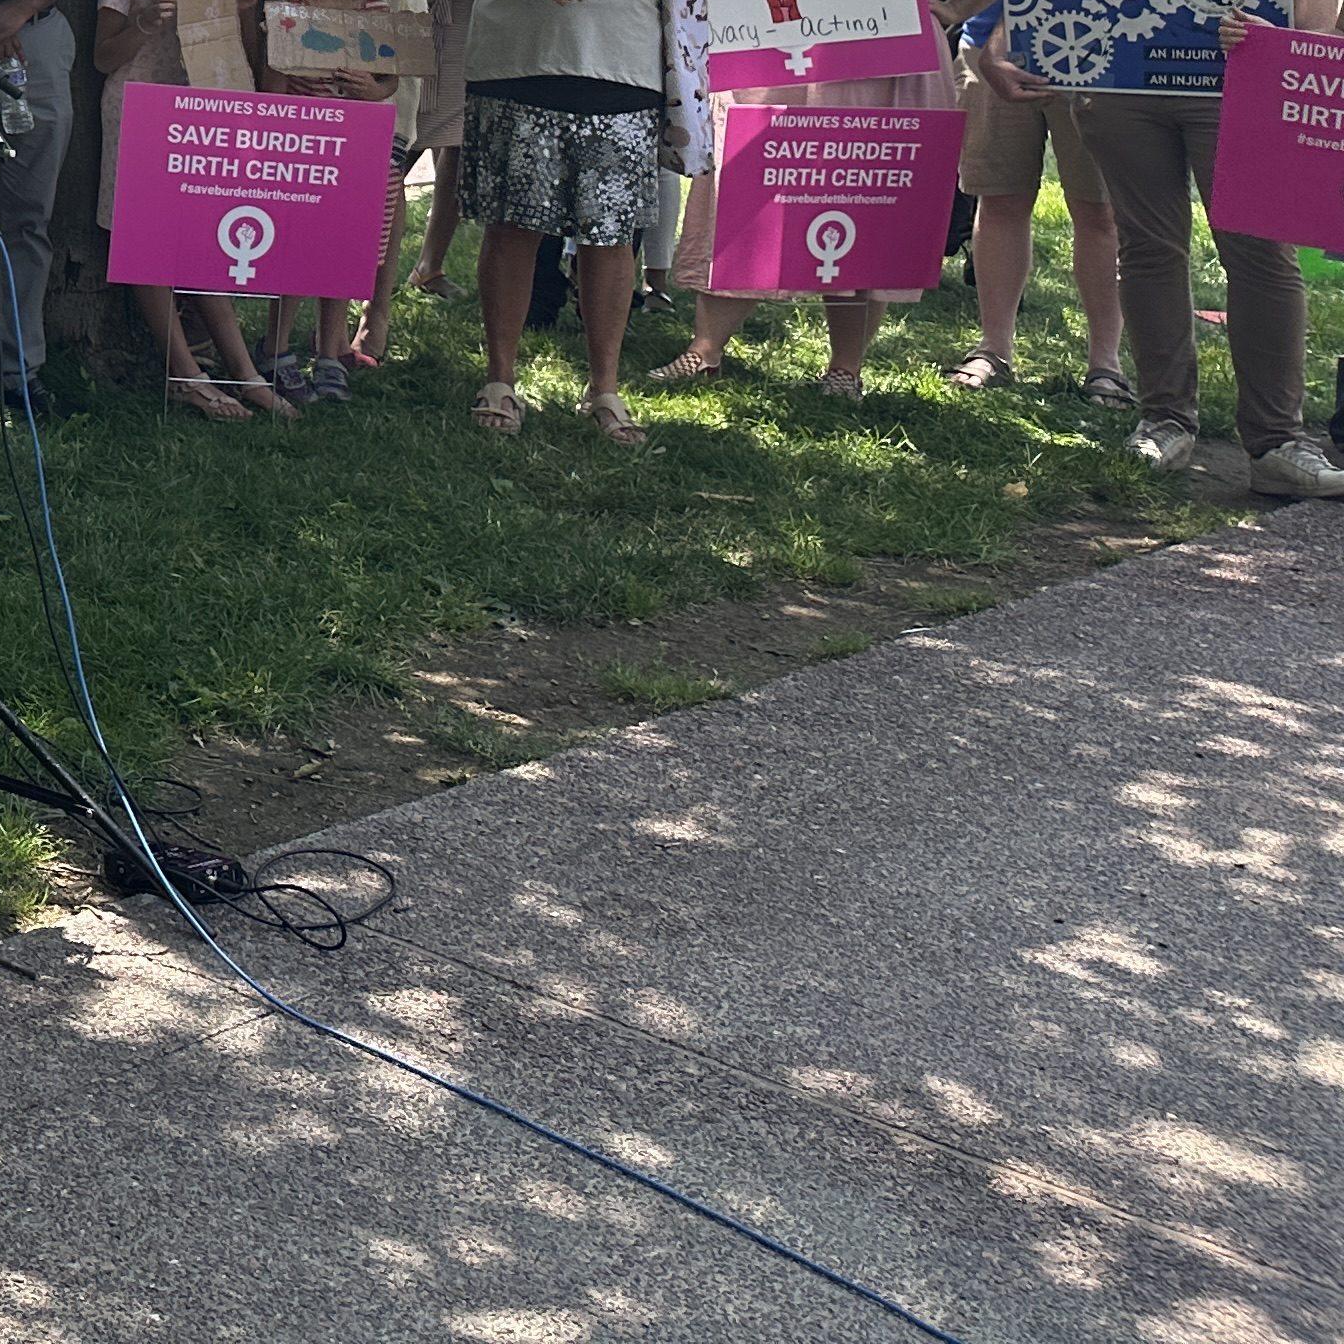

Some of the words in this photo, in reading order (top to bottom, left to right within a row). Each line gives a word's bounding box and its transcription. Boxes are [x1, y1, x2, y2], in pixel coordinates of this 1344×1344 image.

[1149, 47, 1167, 60] AN
[1172, 48, 1218, 61] INJURY
[1290, 40, 1344, 61] MIDW
[1150, 74, 1167, 86] AN
[1172, 74, 1218, 87] INJURY
[174, 96, 253, 115] MIDWIVES
[257, 103, 298, 118] SAVE
[301, 107, 345, 123] LIVES
[1281, 100, 1344, 130] BIRT
[770, 115, 840, 129] MIDWIVES
[842, 116, 879, 129] SAVE
[881, 118, 920, 130] LIVES
[167, 123, 230, 147] SAVE
[235, 129, 347, 156] BURDETT
[763, 140, 819, 159] SAVE
[822, 142, 922, 160] BURDETT
[167, 153, 240, 178] BIRTH
[245, 160, 339, 186] CENTER
[763, 167, 826, 186] BIRTH
[831, 168, 913, 187] CENTER
[179, 182, 322, 204] #saveburdettbirthcenter
